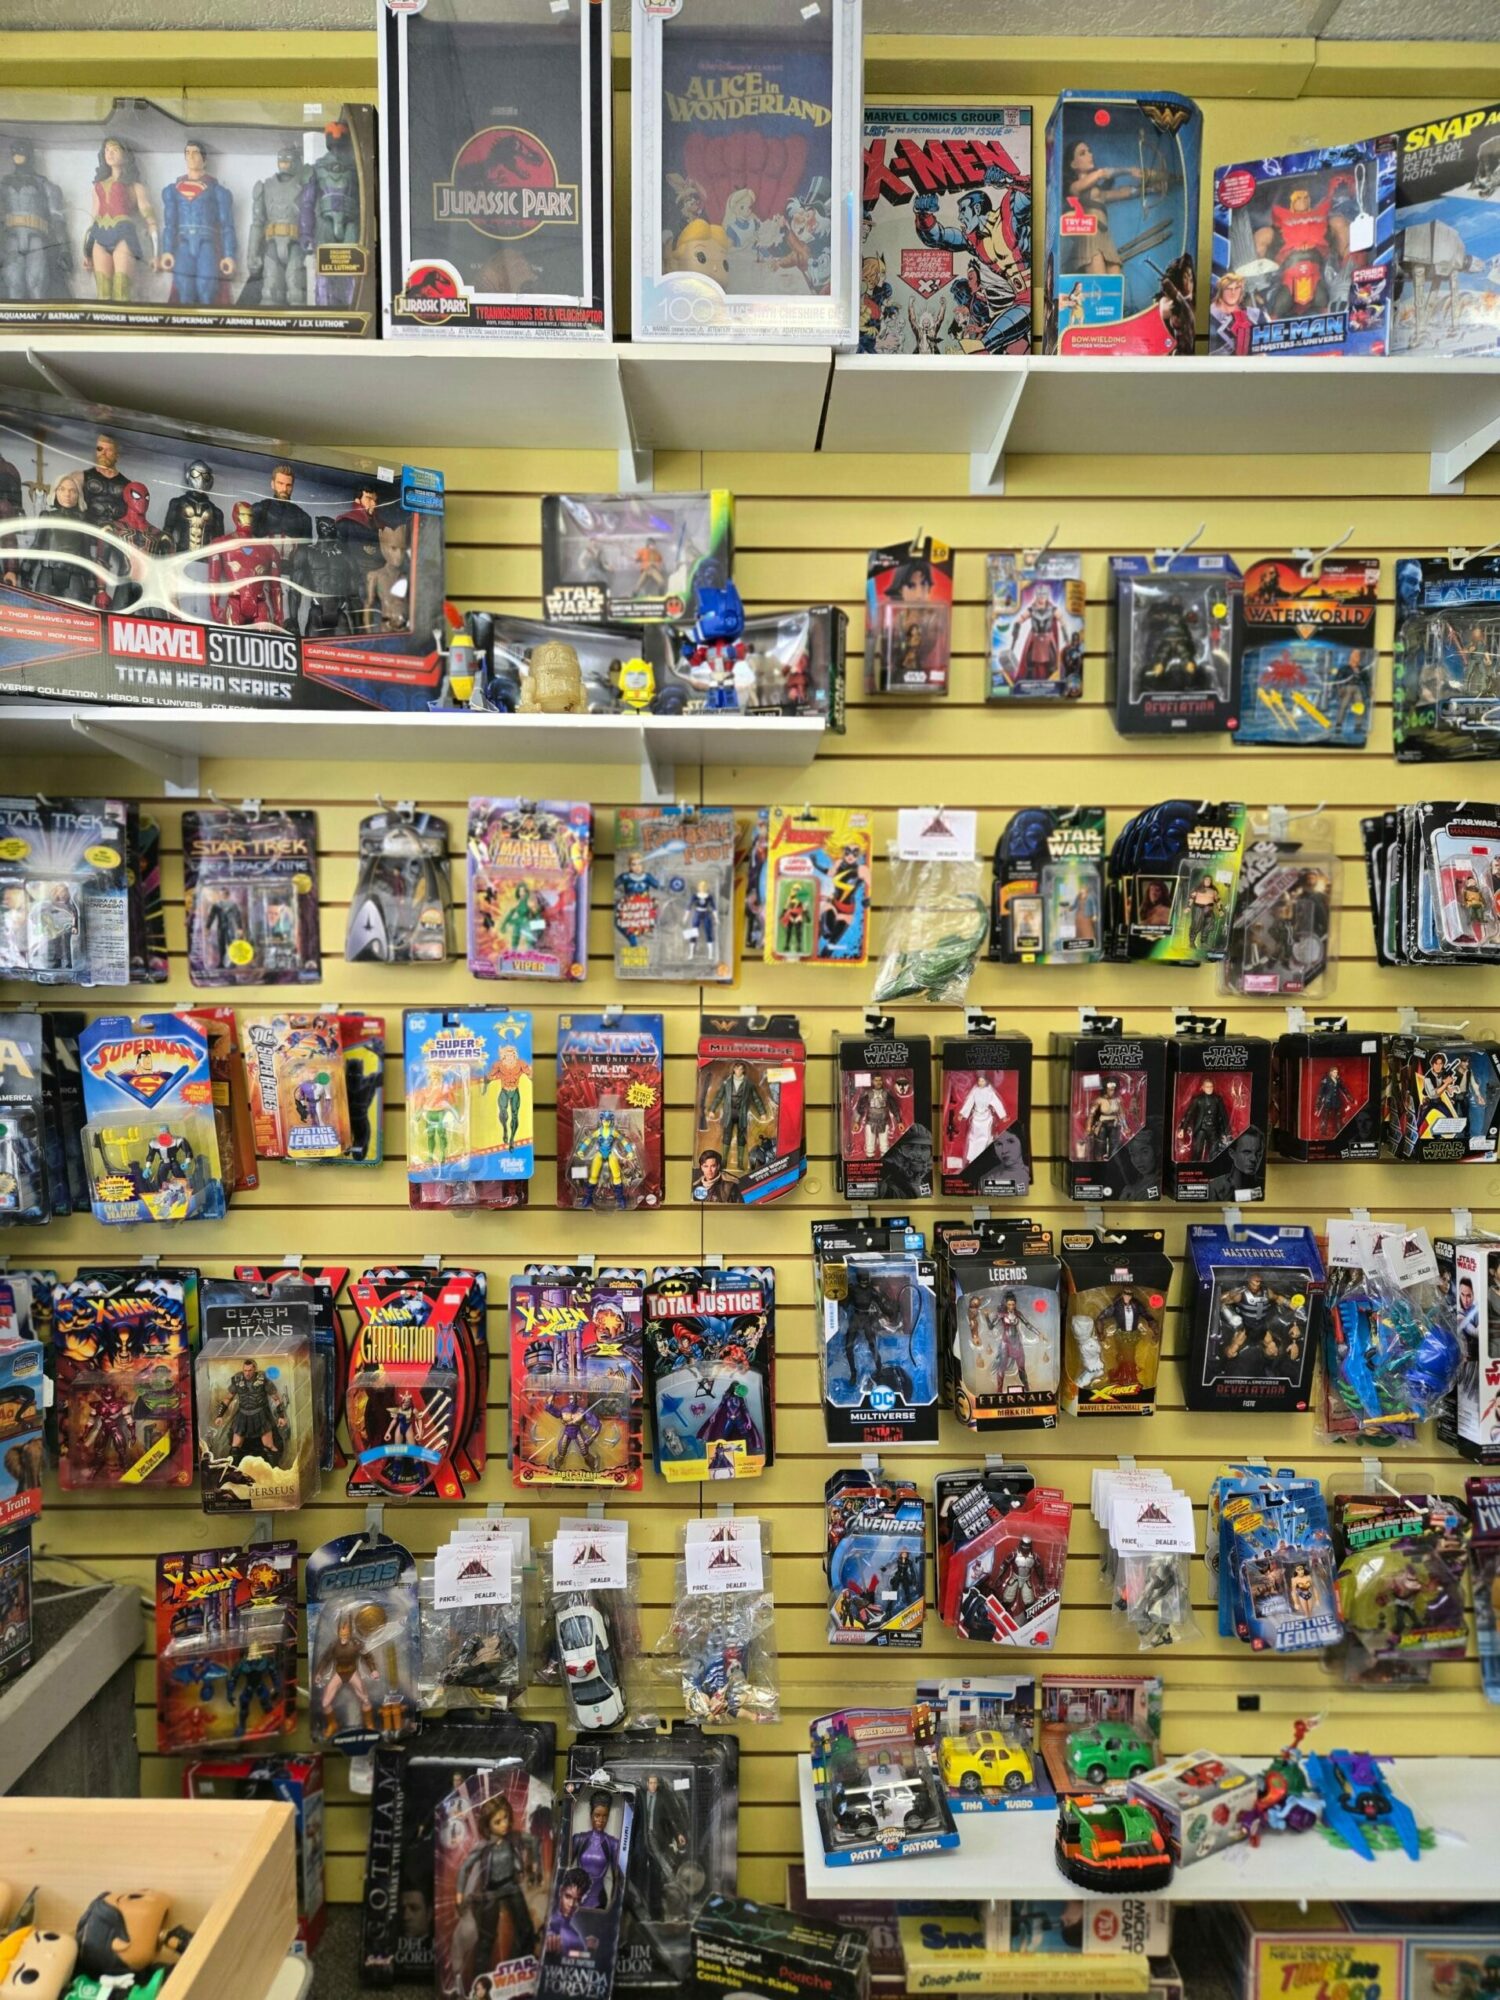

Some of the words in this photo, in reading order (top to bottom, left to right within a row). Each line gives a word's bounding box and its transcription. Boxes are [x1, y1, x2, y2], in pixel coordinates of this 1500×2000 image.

[686, 72, 764, 100] ALICE
[765, 80, 779, 94] in
[664, 90, 832, 128] WONDERLAND
[864, 112, 910, 122] MARVEL
[912, 112, 957, 122] COMICS
[961, 112, 1001, 122] GROUP
[975, 126, 1004, 136] ISSUE
[1403, 112, 1485, 153] SNAP
[1403, 145, 1442, 164] BATTLE
[1444, 141, 1461, 151] ON
[1403, 161, 1420, 172] ICE
[1421, 149, 1465, 168] PLANET
[864, 139, 1021, 206] X-MEN
[440, 189, 519, 216] JURASSIC
[522, 189, 573, 218] PARK
[1065, 218, 1079, 226] TRY
[902, 271, 951, 279] PROFESSOR
[398, 298, 438, 312] JURASSIC
[440, 298, 468, 313] PARK
[0, 312, 38, 320] AQUAMAN
[92, 314, 127, 322] WONDER
[172, 316, 214, 325] SUPERMAN
[226, 318, 254, 326] ARMOR
[254, 318, 287, 327] BATMAN
[314, 320, 345, 328] LUTHOR
[476, 306, 533, 321] TYRANNOSAURUS
[534, 306, 548, 321] REX
[1252, 314, 1344, 345] HE-MAN
[1071, 335, 1127, 344] BOW-WIELDING
[1260, 338, 1295, 352] MASTERS
[1303, 334, 1344, 347] UNIVERSE
[552, 586, 602, 601] STAR
[546, 600, 603, 614] WARS
[8, 611, 29, 619] THOR
[33, 615, 72, 625] MARVEL'S
[73, 619, 95, 627] WASP
[1249, 607, 1366, 624] WATERWORLD
[16, 628, 43, 637] WIDOW
[48, 632, 67, 640] IRON
[67, 634, 95, 643] SPIDER
[112, 620, 203, 660] MARVEL
[208, 633, 298, 671] STUDIOS
[308, 648, 336, 658] CAPTAIN
[337, 651, 366, 661] AMERICA
[115, 665, 172, 686] TITAN
[176, 673, 225, 692] HERO
[229, 677, 293, 700] SERIES
[38, 686, 98, 699] COLLECTION
[106, 692, 140, 704] HÉROS
[142, 696, 155, 704] DE
[157, 698, 203, 710] L'UNIVERS
[1144, 702, 1216, 714] REVELATION
[52, 812, 104, 829] TREK
[1452, 818, 1474, 826] STAR
[1474, 819, 1498, 827] WARS
[1048, 828, 1103, 842] STAR
[1192, 826, 1240, 840] STAR
[192, 840, 246, 855] STAR
[251, 840, 308, 855] TREK
[1048, 842, 1103, 856] WARS
[1187, 838, 1240, 851] WARS
[274, 860, 308, 872] NINE
[512, 960, 545, 972] VIPER
[411, 1020, 425, 1030] DC
[254, 1028, 272, 1043] DC
[436, 1038, 475, 1050] SUPER
[562, 1031, 660, 1056] MASTERS
[710, 1044, 794, 1056] MULTIVERSE
[869, 1042, 909, 1053] STAR
[1103, 1044, 1144, 1056] STAR
[1208, 1045, 1248, 1057] STAR
[91, 1039, 199, 1071] SUPERMAN
[256, 1046, 274, 1074] SUPER
[430, 1048, 481, 1060] POWERS
[582, 1056, 600, 1064] THE
[605, 1056, 655, 1064] UNIVERSE
[864, 1052, 909, 1064] WARS
[1098, 1054, 1144, 1066] WARS
[1203, 1055, 1248, 1067] WARS
[592, 1064, 628, 1074] EVIL-LYN
[258, 1074, 278, 1111] HEROES
[290, 1126, 334, 1136] JUSTICE
[289, 1134, 338, 1147] LEAGUE
[1428, 1142, 1464, 1150] STAR
[1422, 1149, 1465, 1160] WARS
[823, 1241, 834, 1249] 22
[1222, 1248, 1286, 1259] MASTERVERSE
[1332, 1256, 1349, 1264] PRICE
[1457, 1254, 1476, 1266] STAR
[1458, 1262, 1477, 1272] WARS
[988, 1268, 1028, 1282] LEGENDS
[1110, 1274, 1134, 1282] LEGENDS
[88, 1298, 153, 1324] X-MEN
[649, 1294, 695, 1318] TOTAL
[697, 1291, 763, 1314] JUSTICE
[226, 1306, 289, 1320] CLASH
[364, 1306, 412, 1325] X-MEN
[516, 1306, 590, 1334] X-MEN
[240, 1318, 252, 1326] OF
[222, 1324, 294, 1340] TITANS
[360, 1325, 436, 1365] GENERATION
[1216, 1384, 1286, 1396] REVELATION
[872, 1392, 895, 1406] DC
[978, 1392, 1054, 1405] ETERNALS
[997, 1408, 1035, 1416] MAKKARI
[1080, 1404, 1105, 1412] MARVEL'S
[850, 1412, 916, 1421] MULTIVERSE
[249, 1486, 295, 1498] PERSEUS
[952, 1482, 987, 1515] SNAKE
[6, 1495, 31, 1514] Train
[958, 1497, 994, 1530] SNAKE
[846, 1514, 925, 1534] AVENGERS
[964, 1514, 991, 1540] EYES
[1348, 1522, 1423, 1545] TURTLES
[1155, 1538, 1178, 1546] DEALER
[163, 1566, 244, 1600] X-MEN
[320, 1561, 402, 1590] CRISIS
[692, 1584, 709, 1592] PRICE
[726, 1582, 748, 1590] DEALER
[438, 1596, 456, 1604] PRICE
[474, 1592, 497, 1600] DEALER
[1027, 1593, 1058, 1619] NINJA
[1277, 1614, 1335, 1632] JUSTICE
[1276, 1627, 1339, 1649] LEAGUE
[961, 1801, 984, 1811] TINA
[1004, 1799, 1034, 1809] TURBO
[368, 1767, 399, 1940] GOTHAM
[850, 1848, 882, 1862] PATTY
[902, 1839, 942, 1854] PATROL
[1122, 1900, 1134, 1954] CRAFT
[1133, 1900, 1146, 1955] MICRO
[630, 1944, 651, 1958] JIM
[696, 1940, 725, 1953] Radio
[725, 1946, 762, 1964] Control
[696, 1948, 728, 1964] Racing
[730, 1956, 748, 1967] Car
[496, 1957, 538, 1976] STAR
[696, 1960, 722, 1972] Race
[493, 1969, 536, 1989] WARS
[544, 1965, 608, 1988] WAKANDA
[918, 1970, 982, 1988] Snap-Blox
[544, 1978, 606, 1998] FOREVER
